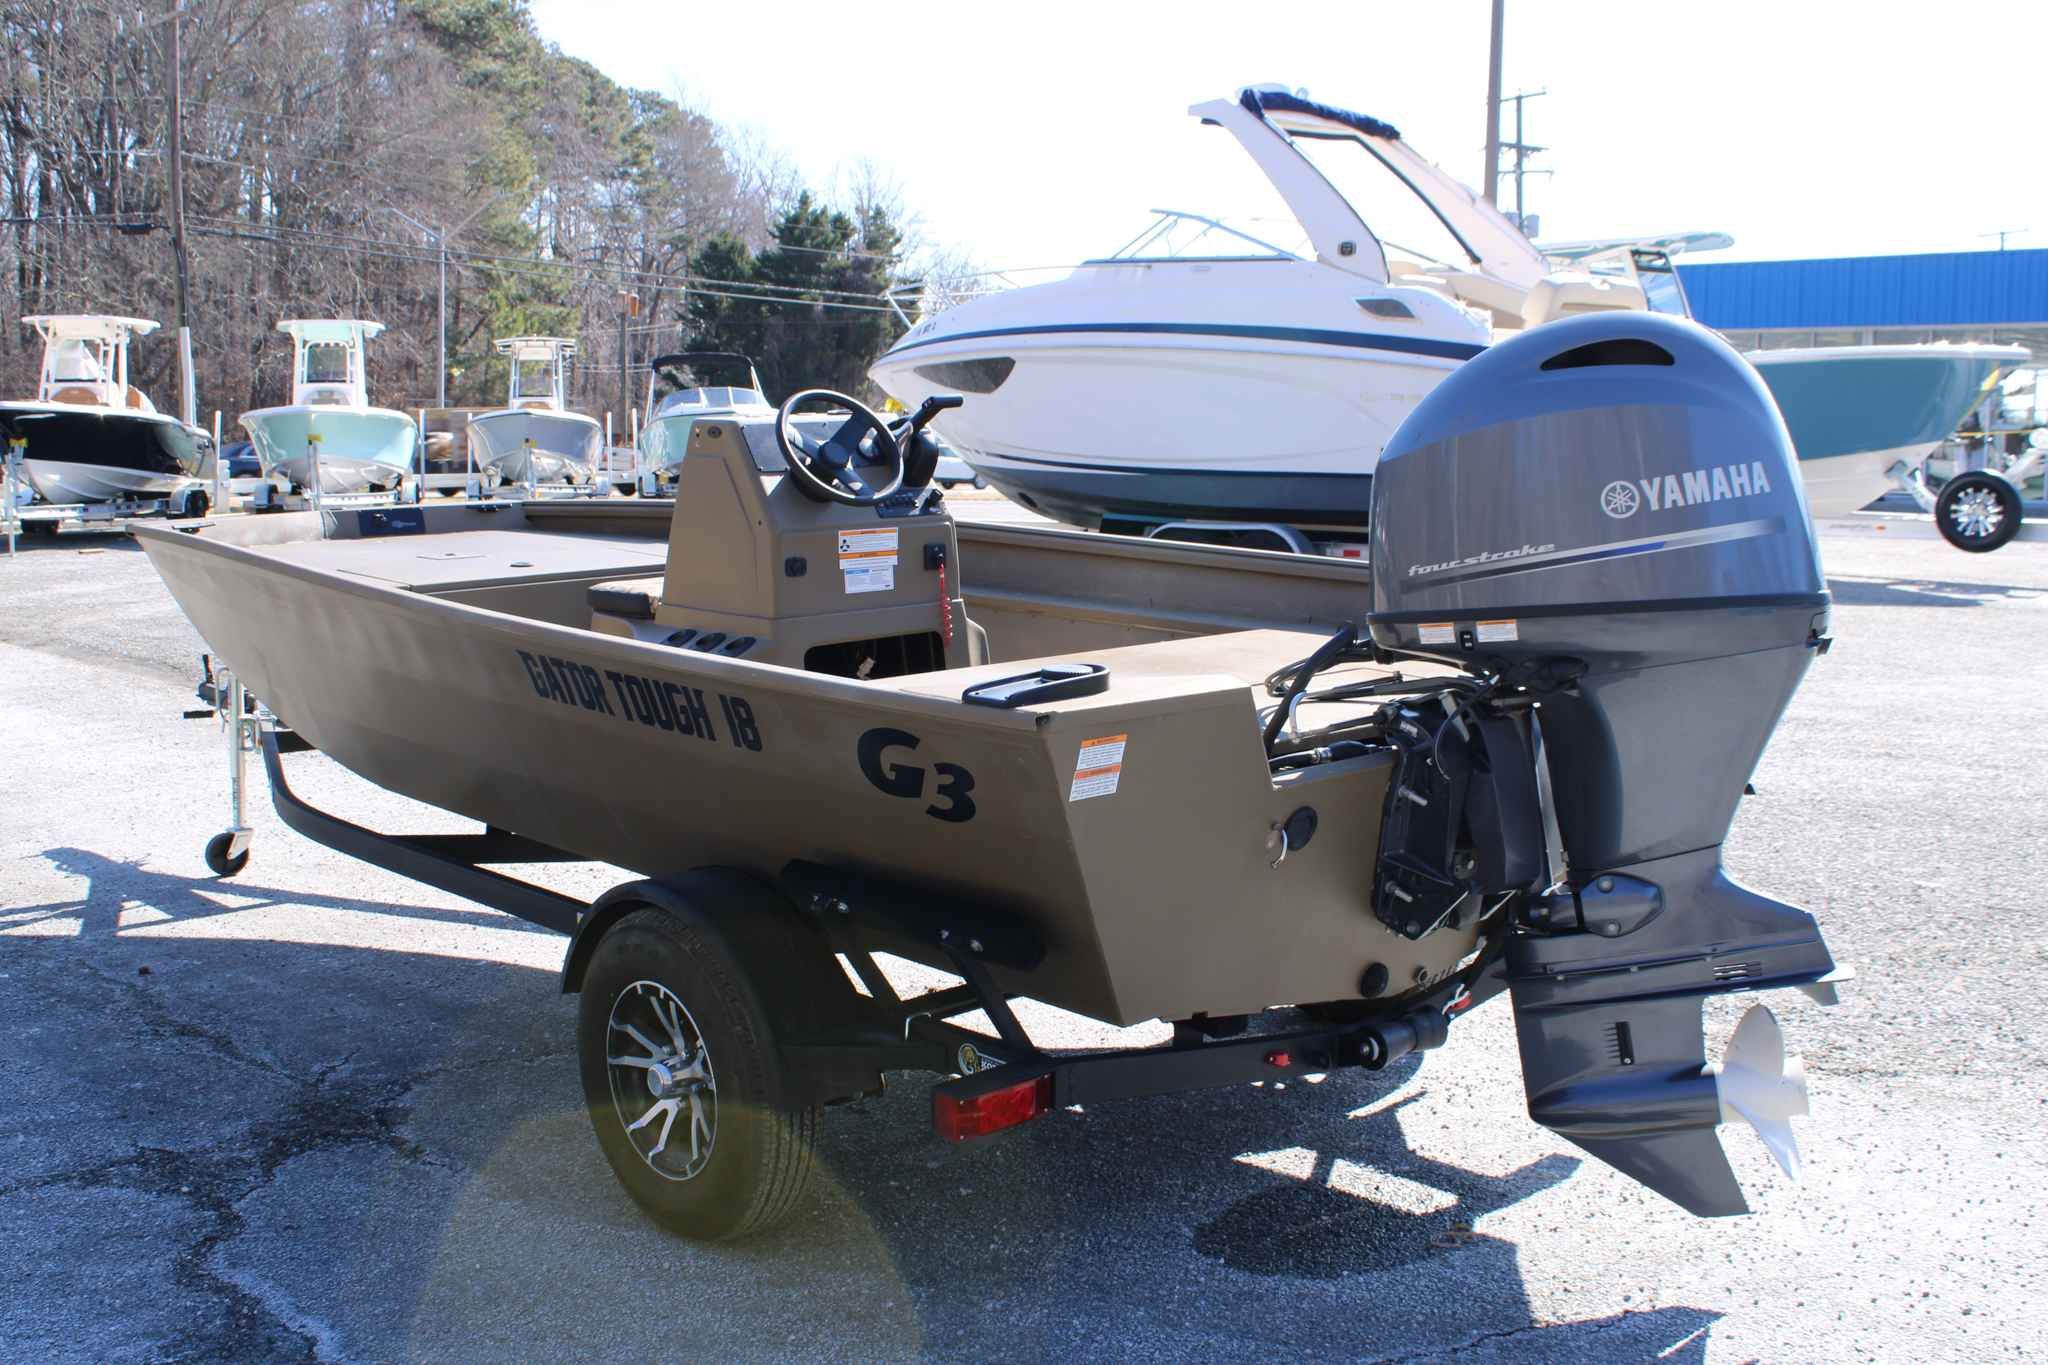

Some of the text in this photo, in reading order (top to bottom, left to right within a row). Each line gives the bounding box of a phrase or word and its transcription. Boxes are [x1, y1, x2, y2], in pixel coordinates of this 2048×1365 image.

[1641, 461, 1771, 511] YAMAHA
[515, 650, 763, 752] GATOR TOUGH 18
[856, 727, 977, 824] G3
